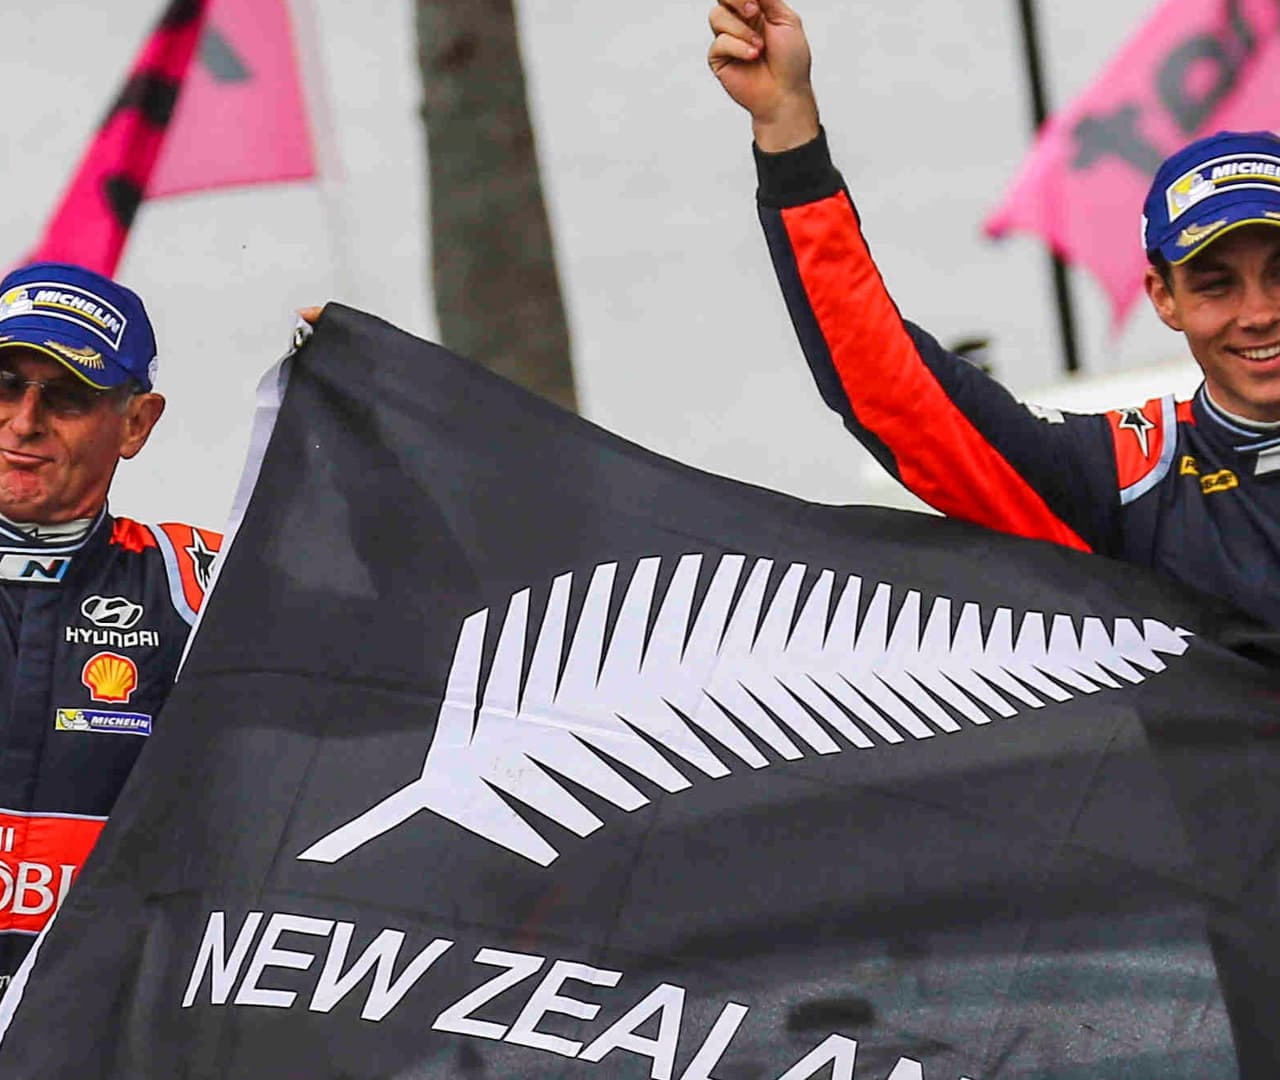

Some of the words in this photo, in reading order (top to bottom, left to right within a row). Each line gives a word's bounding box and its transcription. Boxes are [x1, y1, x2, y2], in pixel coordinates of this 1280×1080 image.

[35, 289, 121, 334] MICHELIN
[65, 626, 160, 648] HYUNDAI
[90, 715, 150, 729] MICHELIN
[181, 910, 453, 1023] NEW
